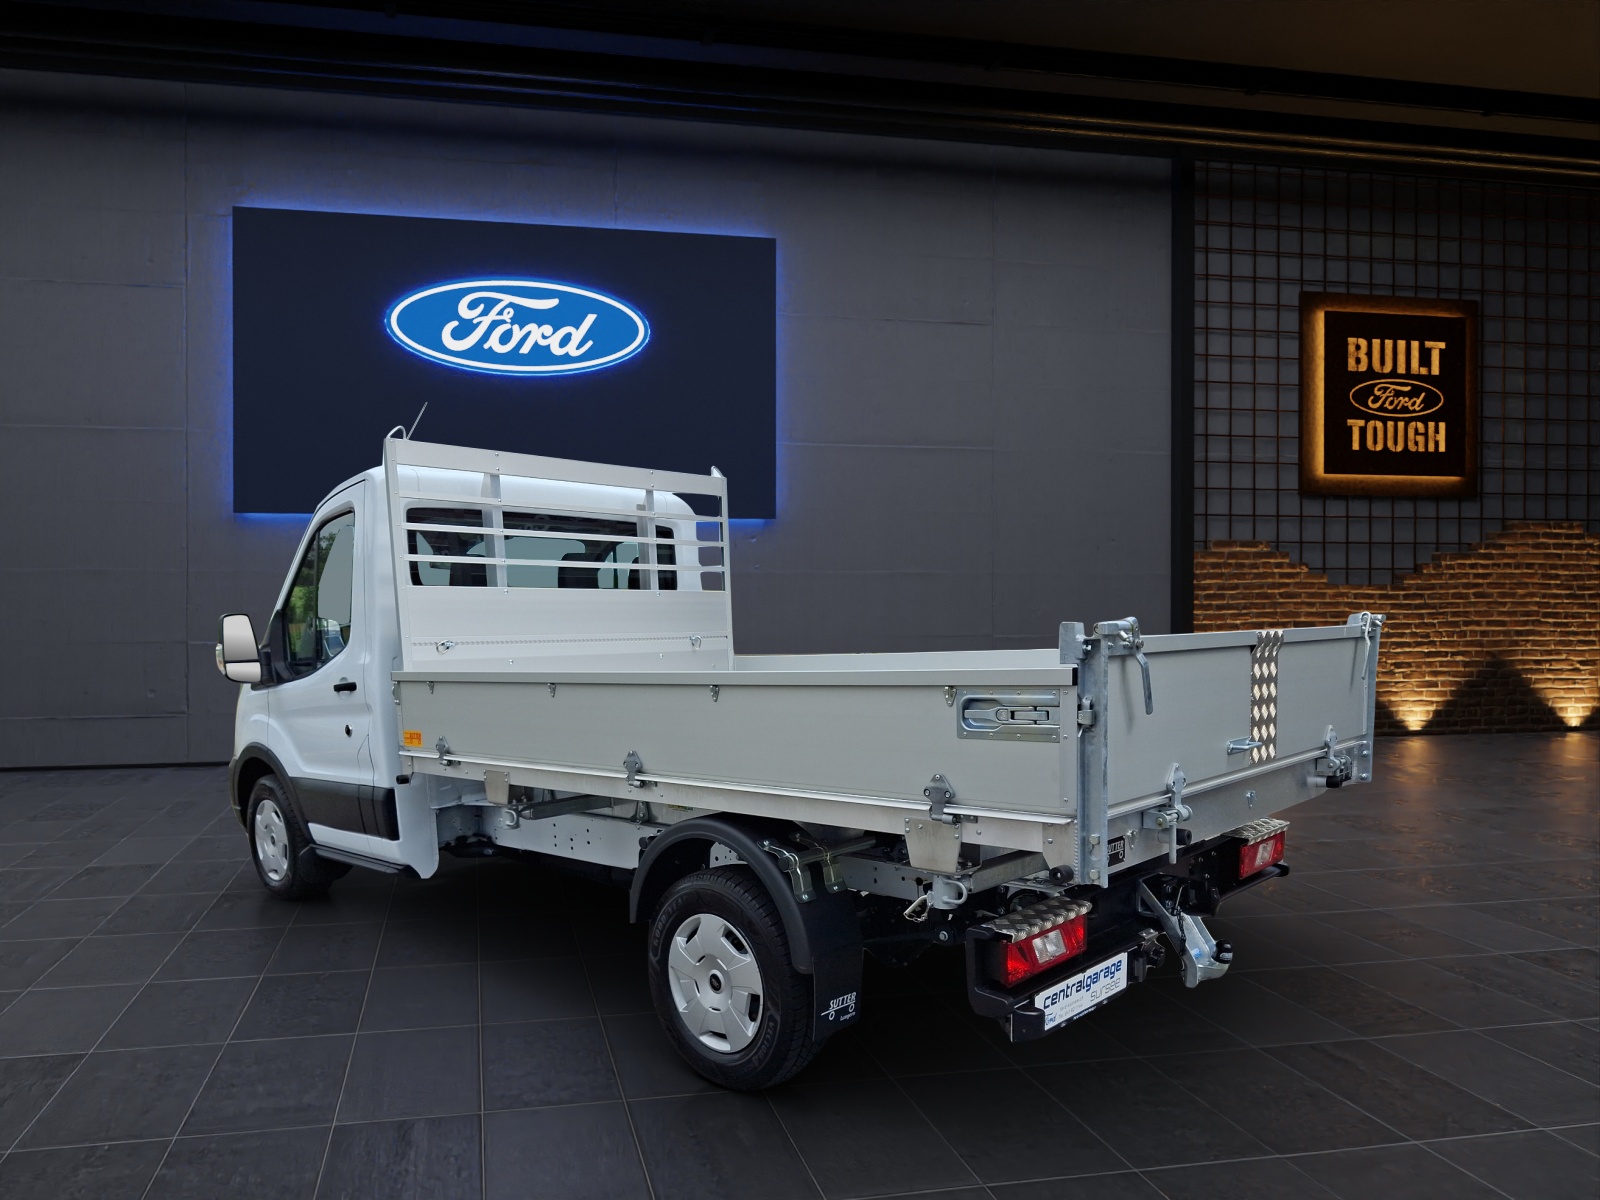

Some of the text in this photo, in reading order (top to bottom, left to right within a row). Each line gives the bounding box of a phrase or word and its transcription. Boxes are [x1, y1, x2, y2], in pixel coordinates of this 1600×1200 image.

[441, 291, 597, 357] Ford
[1347, 337, 1446, 376] BUILT
[1367, 383, 1426, 411] Ford
[1346, 419, 1446, 453] TOUGH
[829, 991, 857, 1010] SUTTER
[1043, 959, 1122, 1010] centralgarage
[1090, 977, 1121, 1002] sursee
